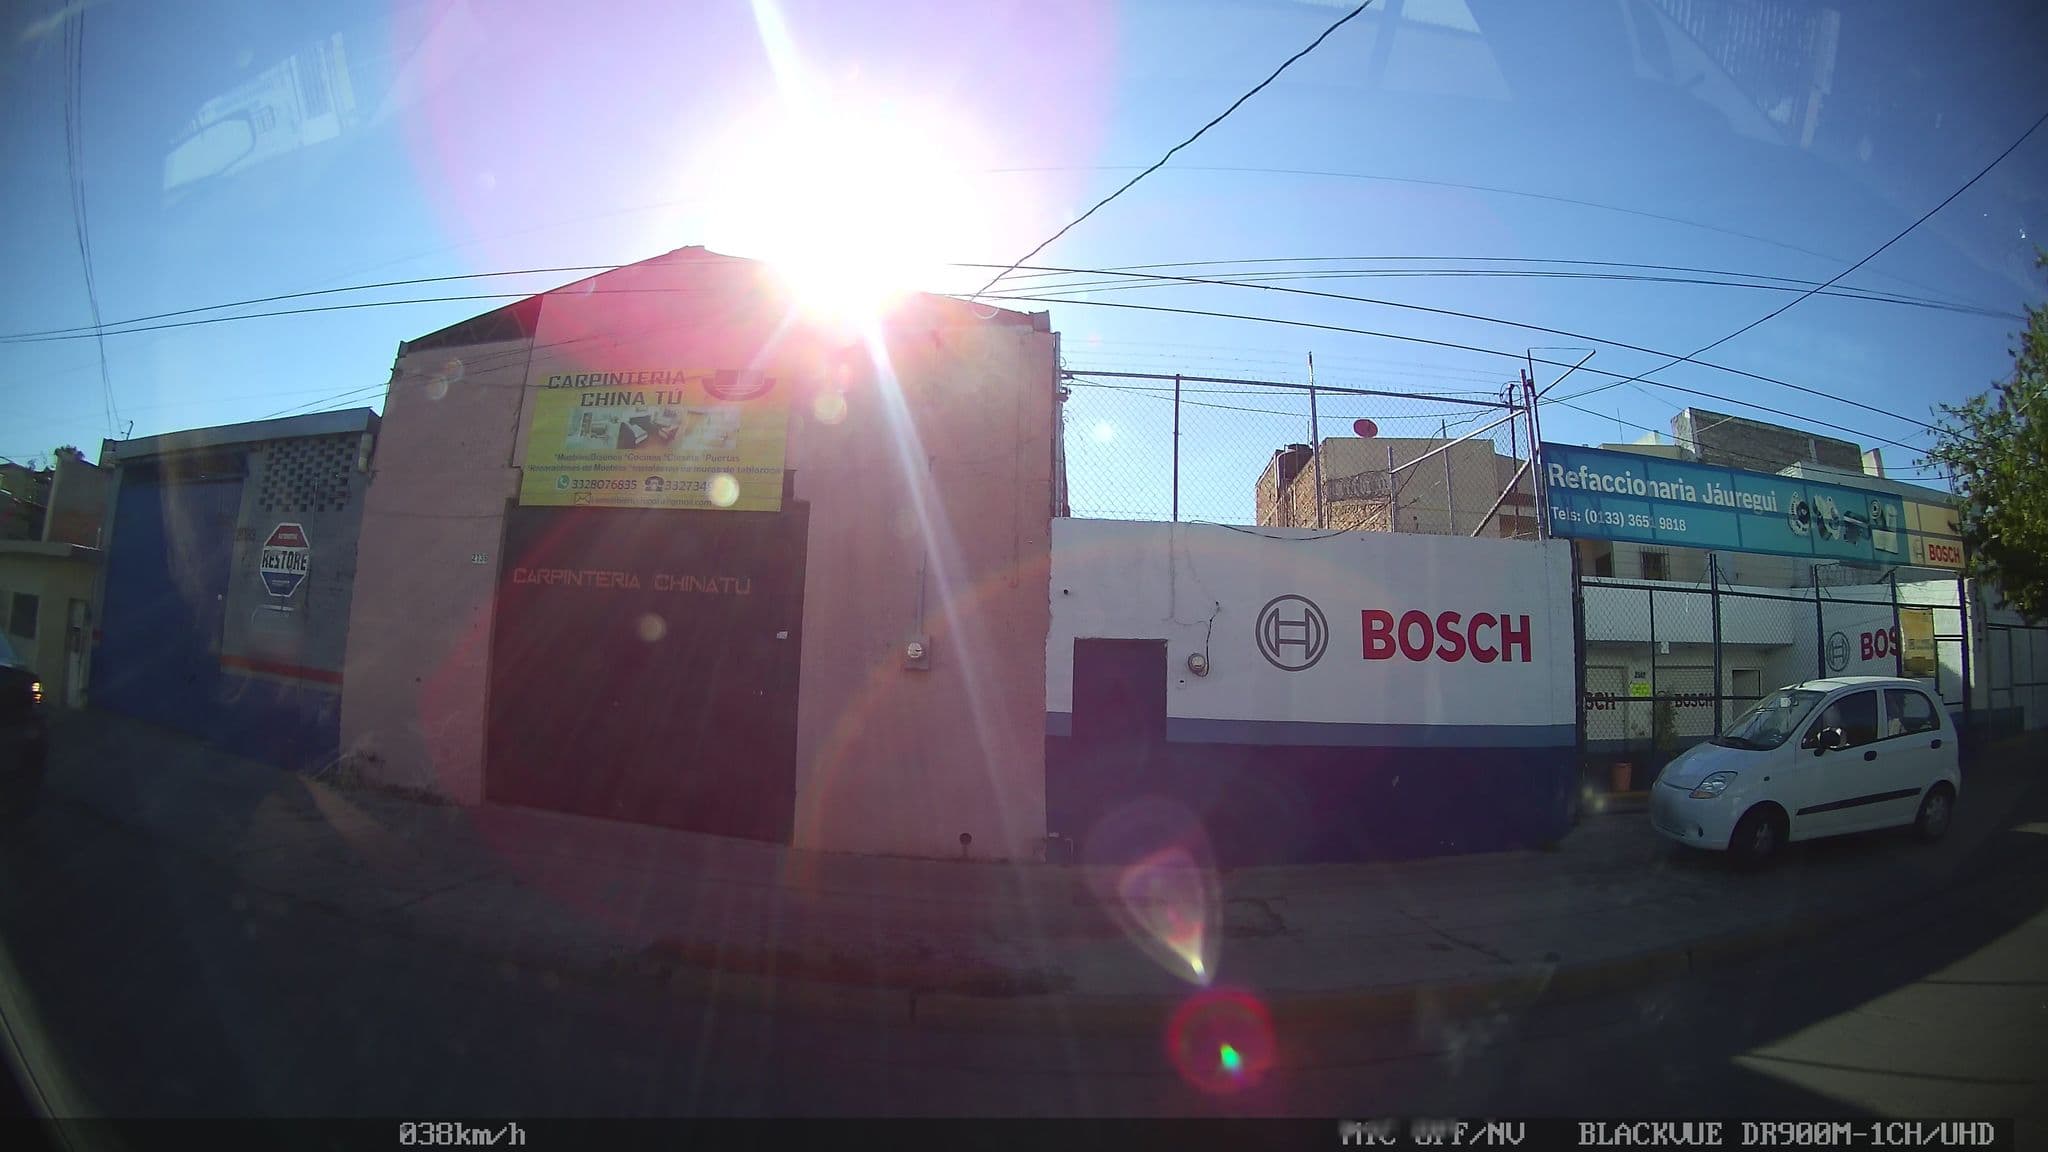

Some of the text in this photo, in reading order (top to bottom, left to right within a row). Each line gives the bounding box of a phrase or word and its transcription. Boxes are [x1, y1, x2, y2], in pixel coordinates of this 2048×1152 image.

[548, 370, 686, 389] CARPINTERIA
[581, 391, 645, 407] CHINA
[571, 479, 638, 491] 3328076835
[1547, 462, 1778, 515] Refaccionaria Jáuregui
[1551, 506, 1581, 523] Tels:
[1585, 508, 1625, 528] (0133)
[1659, 517, 1687, 532] 9818
[1928, 543, 1960, 564] BOSCH
[513, 567, 641, 589] CARPINTERIA
[1361, 609, 1532, 663] BOSCH
[1860, 626, 1898, 662] BOS
[1584, 691, 1713, 711] SCH BOSCH
